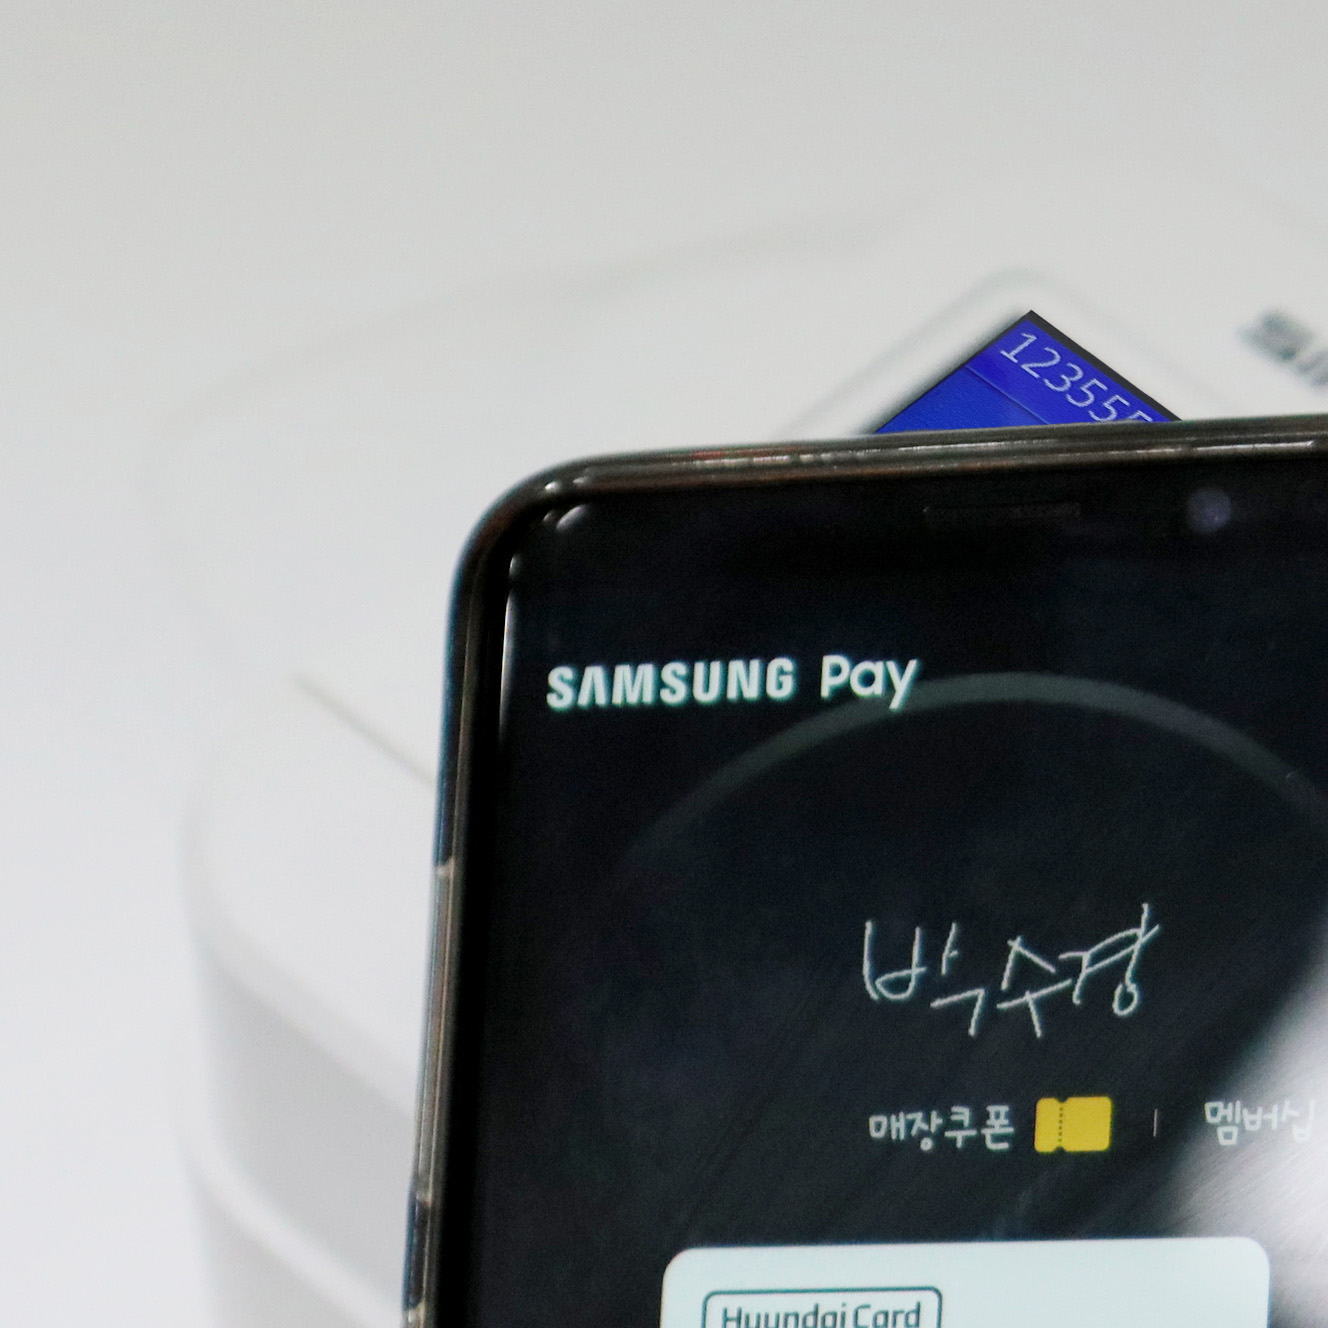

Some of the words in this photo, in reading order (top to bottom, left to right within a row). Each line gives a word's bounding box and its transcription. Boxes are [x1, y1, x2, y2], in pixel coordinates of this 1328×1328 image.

[1000, 332, 1154, 423] 12355
[546, 656, 796, 711] SAMSUNG
[820, 654, 918, 711] Pay
